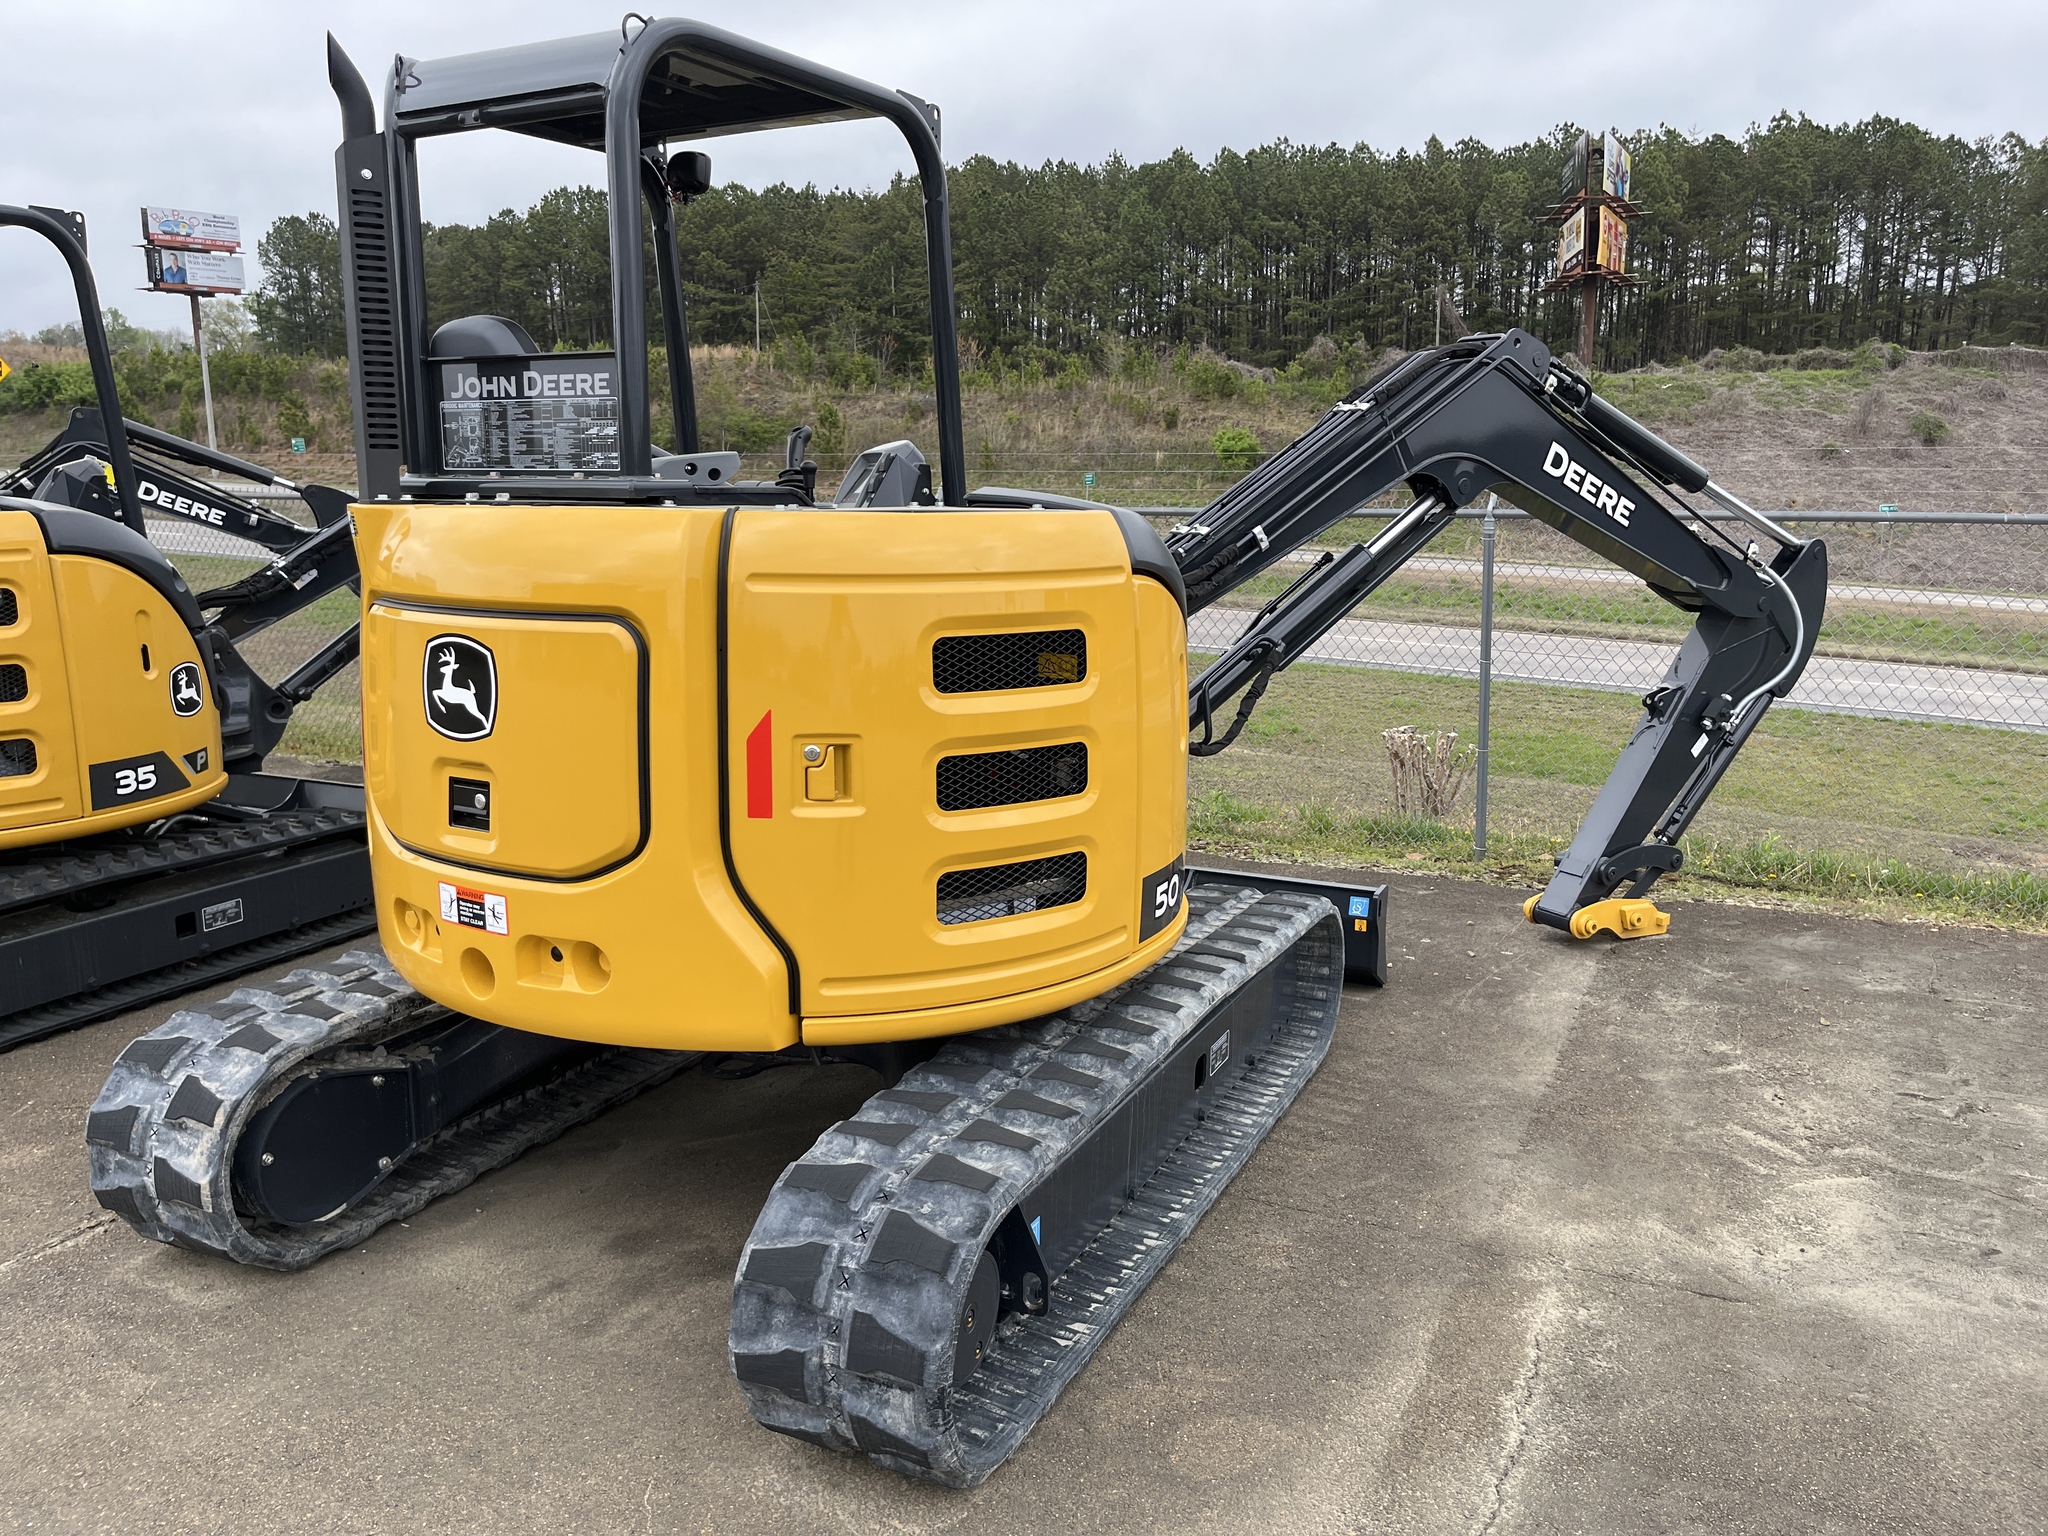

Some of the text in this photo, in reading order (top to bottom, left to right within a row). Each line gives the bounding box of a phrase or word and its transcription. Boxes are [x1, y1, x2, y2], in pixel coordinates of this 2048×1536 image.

[451, 371, 610, 399] JOHN DEERE
[1542, 441, 1636, 527] DEERE
[137, 481, 227, 526] DEERE
[197, 750, 206, 771] P
[115, 764, 157, 795] 35
[459, 890, 484, 900] WARNING
[1154, 873, 1179, 918] 50
[470, 918, 484, 926] CLEAR
